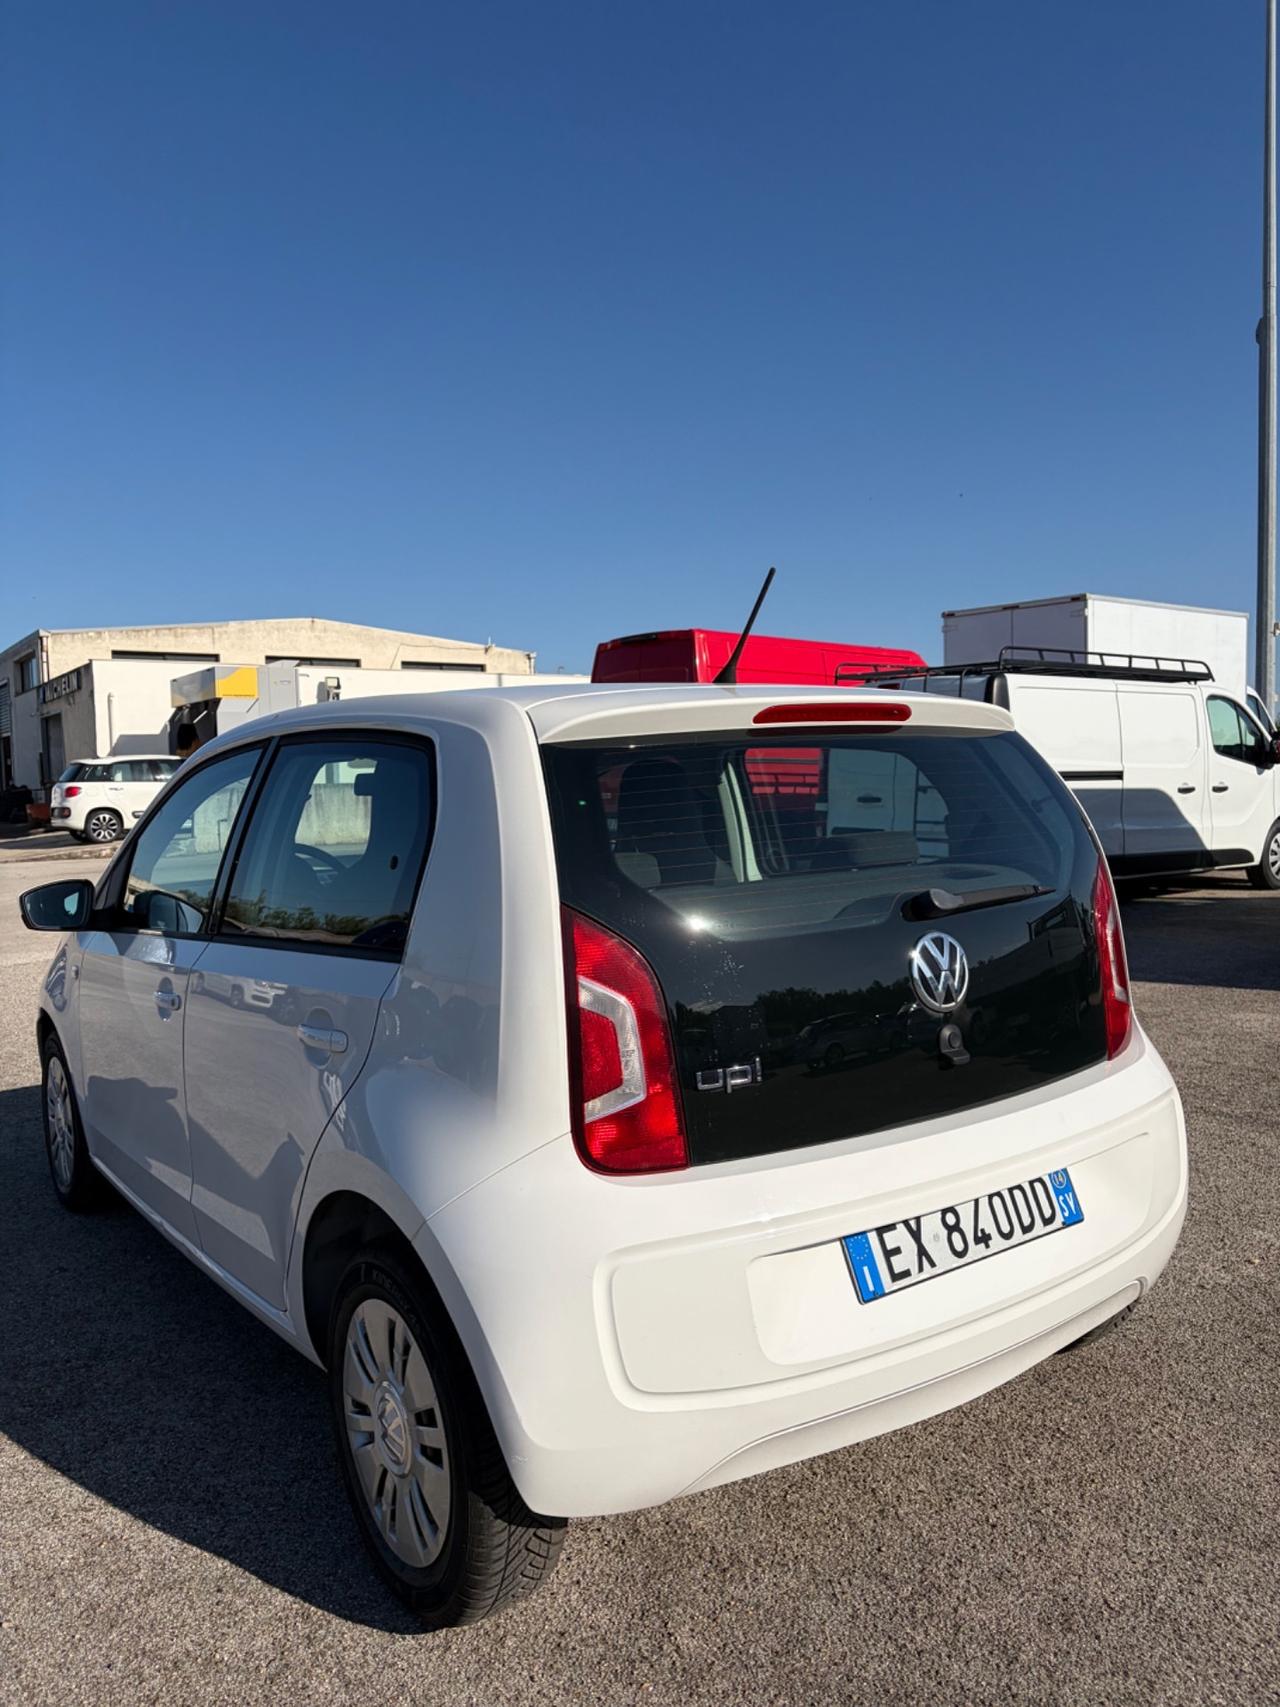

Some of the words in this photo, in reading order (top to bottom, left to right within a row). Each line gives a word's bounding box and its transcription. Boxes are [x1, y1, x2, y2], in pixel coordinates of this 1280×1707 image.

[695, 1055, 763, 1094] up!
[1058, 1191, 1077, 1217] SV
[875, 1215, 937, 1283] EX
[940, 1176, 1057, 1259] 840DD
[863, 1265, 875, 1292] I
